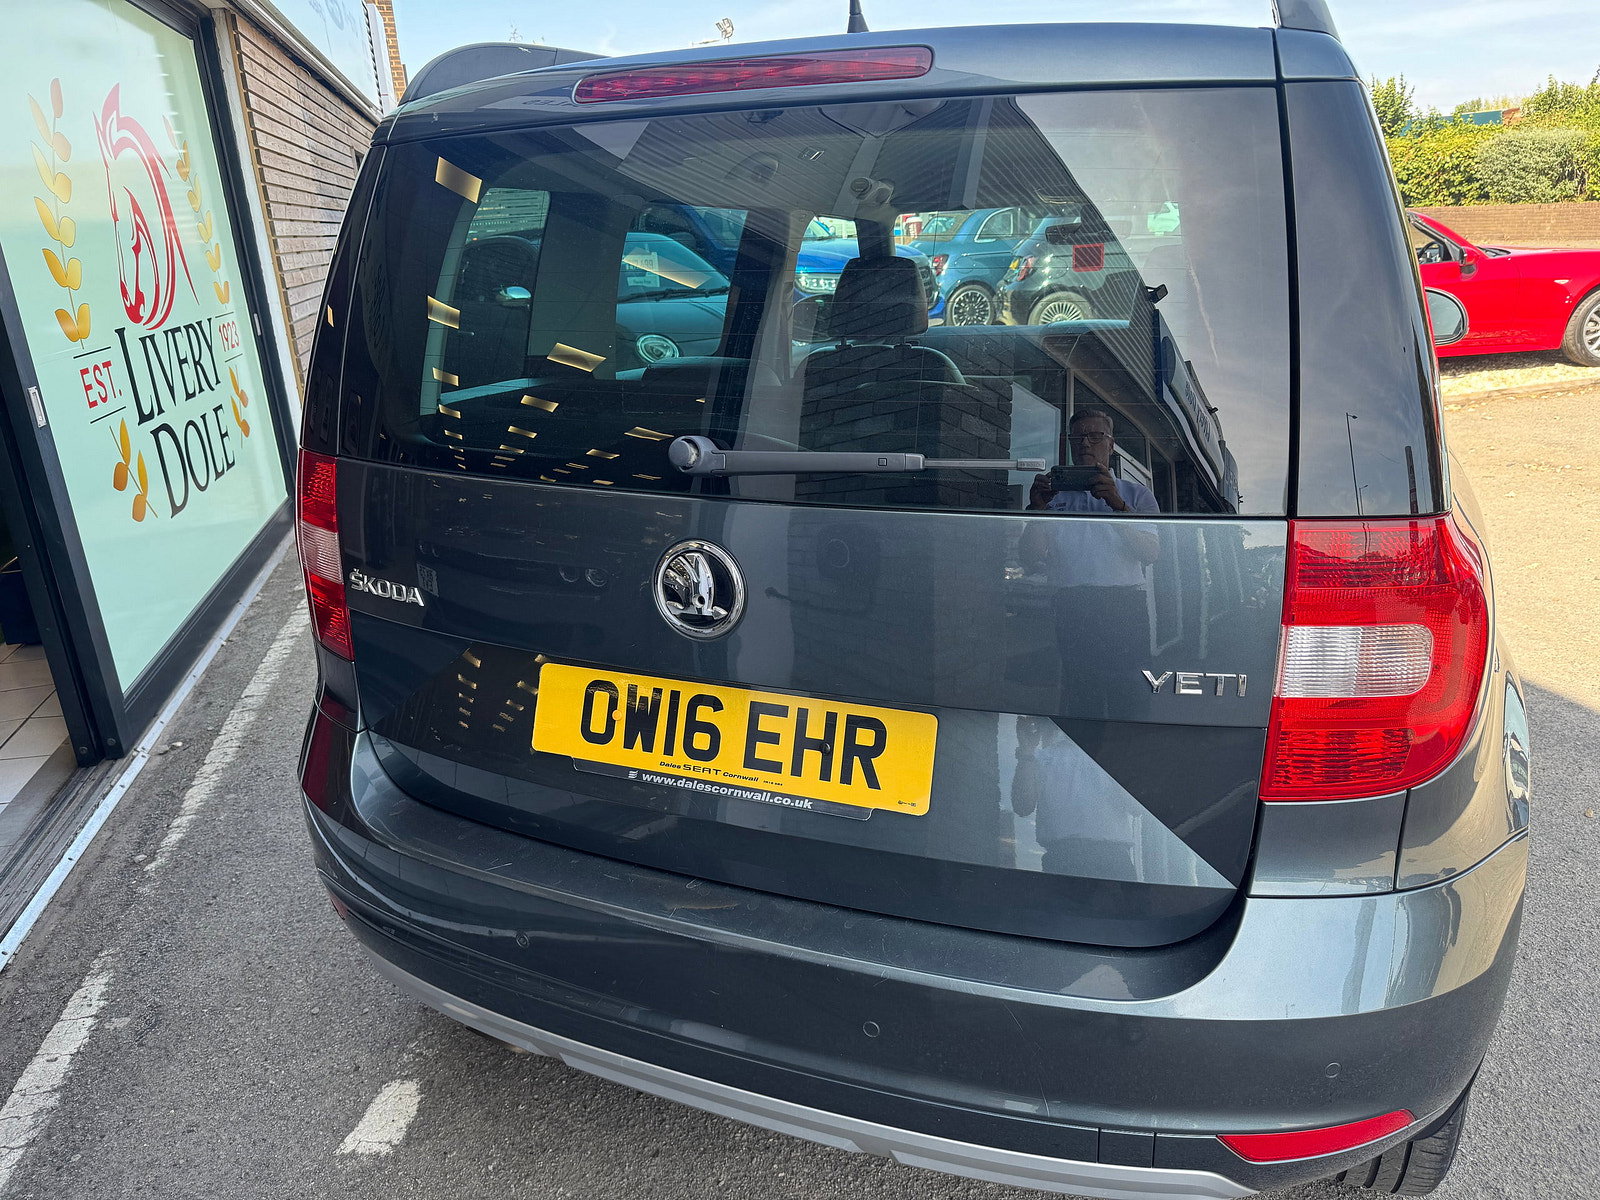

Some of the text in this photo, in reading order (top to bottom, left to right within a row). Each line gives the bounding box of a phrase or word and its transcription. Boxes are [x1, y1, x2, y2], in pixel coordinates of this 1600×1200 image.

[218, 321, 240, 353] 1923
[80, 360, 123, 410] EST.
[114, 316, 222, 427] LIVERY
[149, 403, 237, 519] DOLE
[348, 567, 425, 607] ŠKODA
[1141, 669, 1248, 698] YETI
[579, 678, 888, 791] OW16 EHR
[641, 772, 813, 810] www.dalescornwall.co.uk
[659, 760, 682, 770] Dales
[682, 763, 722, 777] SEAT
[722, 771, 760, 783] Cornwall
